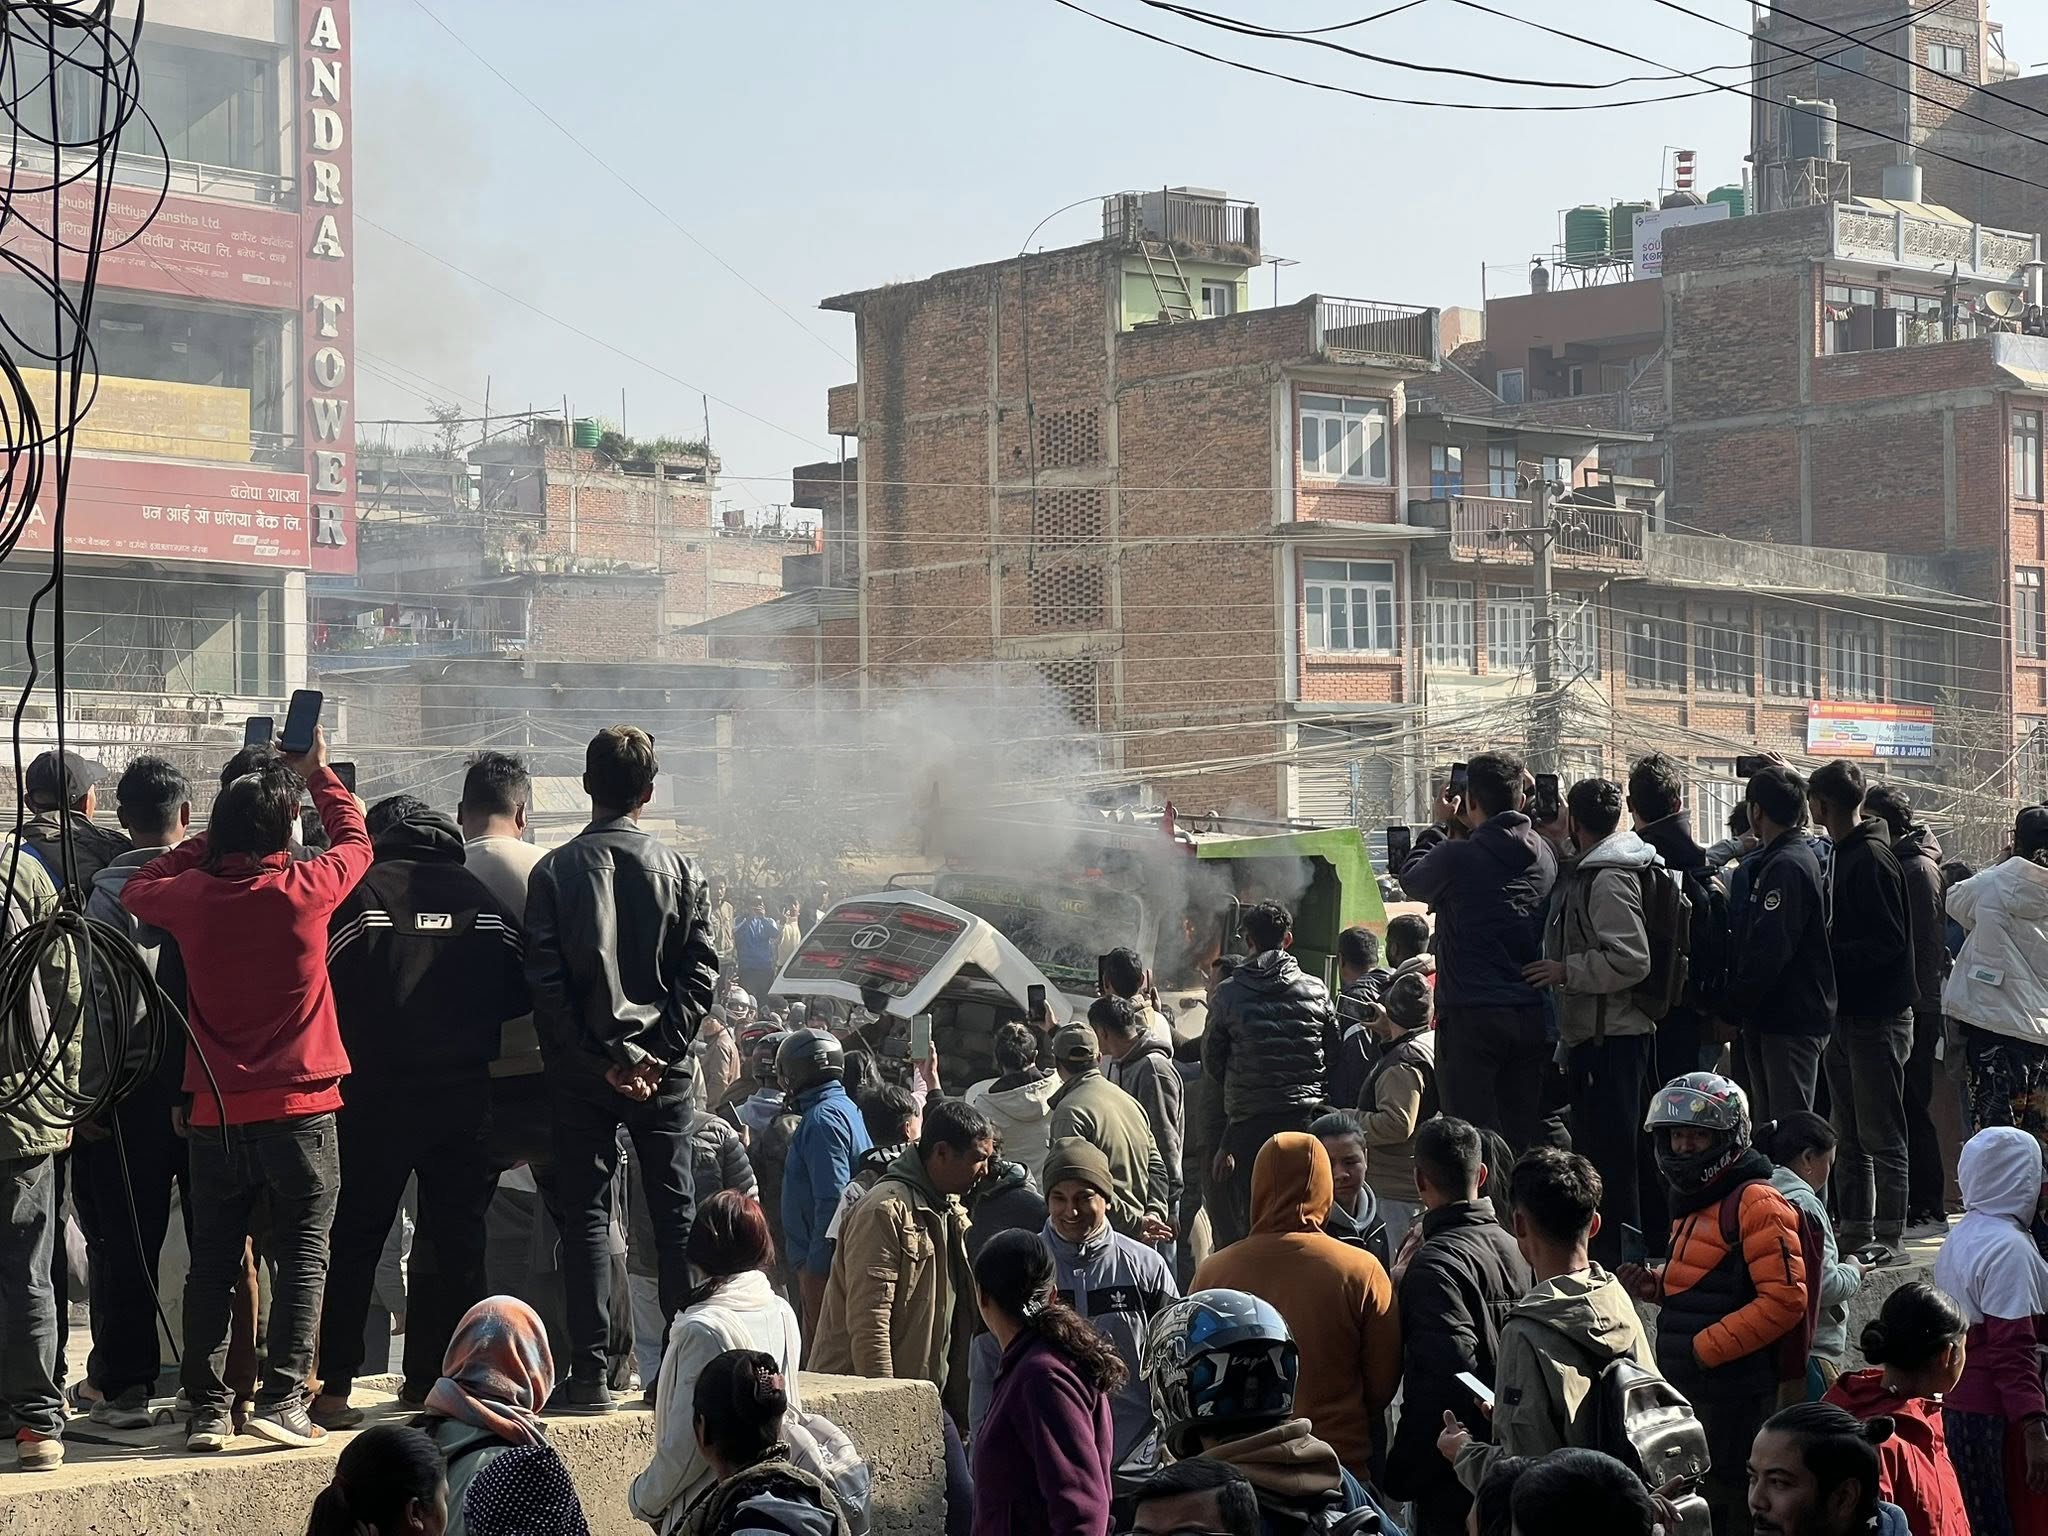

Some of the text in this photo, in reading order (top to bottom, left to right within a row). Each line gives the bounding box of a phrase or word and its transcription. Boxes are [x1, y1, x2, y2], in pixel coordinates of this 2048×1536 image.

[109, 202, 147, 220] Bittiya
[153, 208, 199, 226] anstha
[202, 215, 221, 229] Ltd.
[216, 242, 232, 258] लि.
[1642, 240, 1664, 252] SOU
[1642, 251, 1664, 262] KOR
[310, 6, 348, 546] ANDRA TOWER
[229, 481, 300, 503] बनेपा शाखा
[142, 505, 162, 520] एन
[166, 504, 191, 524] आई
[194, 507, 210, 524] सी
[214, 509, 251, 527] एशिया
[283, 514, 302, 531] लि.
[1875, 745, 1899, 756] KOREA
[1900, 746, 1907, 756] &
[1907, 747, 1931, 757] JAPAN
[420, 915, 448, 927] F-7
[1700, 1150, 1732, 1182] JOKER
